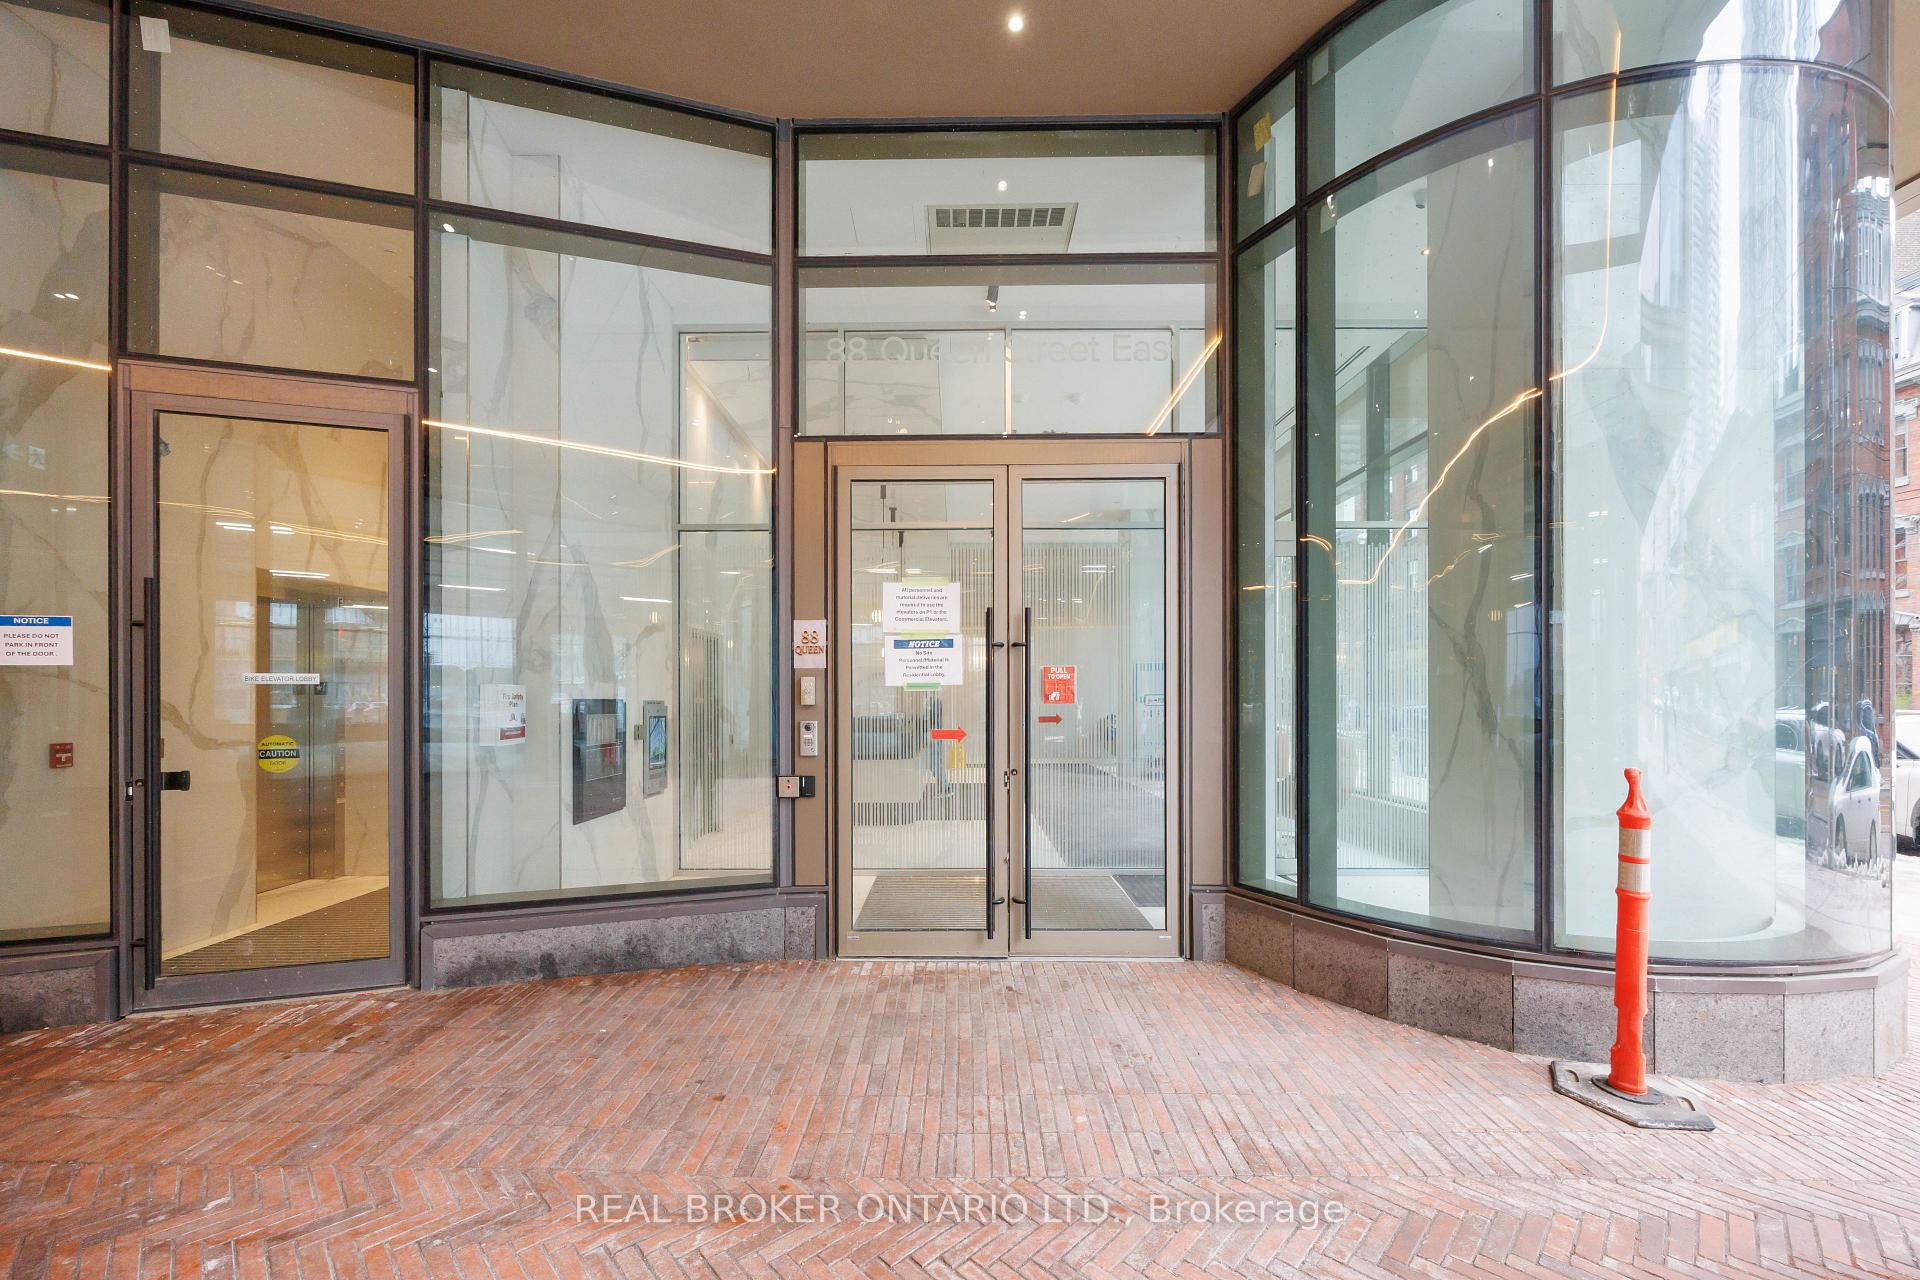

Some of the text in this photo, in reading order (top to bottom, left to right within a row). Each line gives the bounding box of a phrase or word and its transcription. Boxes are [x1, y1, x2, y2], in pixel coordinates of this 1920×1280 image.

[826, 334, 1174, 363] 88 Queen Sreet Eas
[13, 617, 49, 625] NOTICE
[801, 630, 819, 645] 88
[907, 640, 942, 648] NOTICE
[794, 645, 825, 656] QUEEN
[260, 675, 294, 683] ELEVATOR
[259, 750, 297, 758] CAUTION
